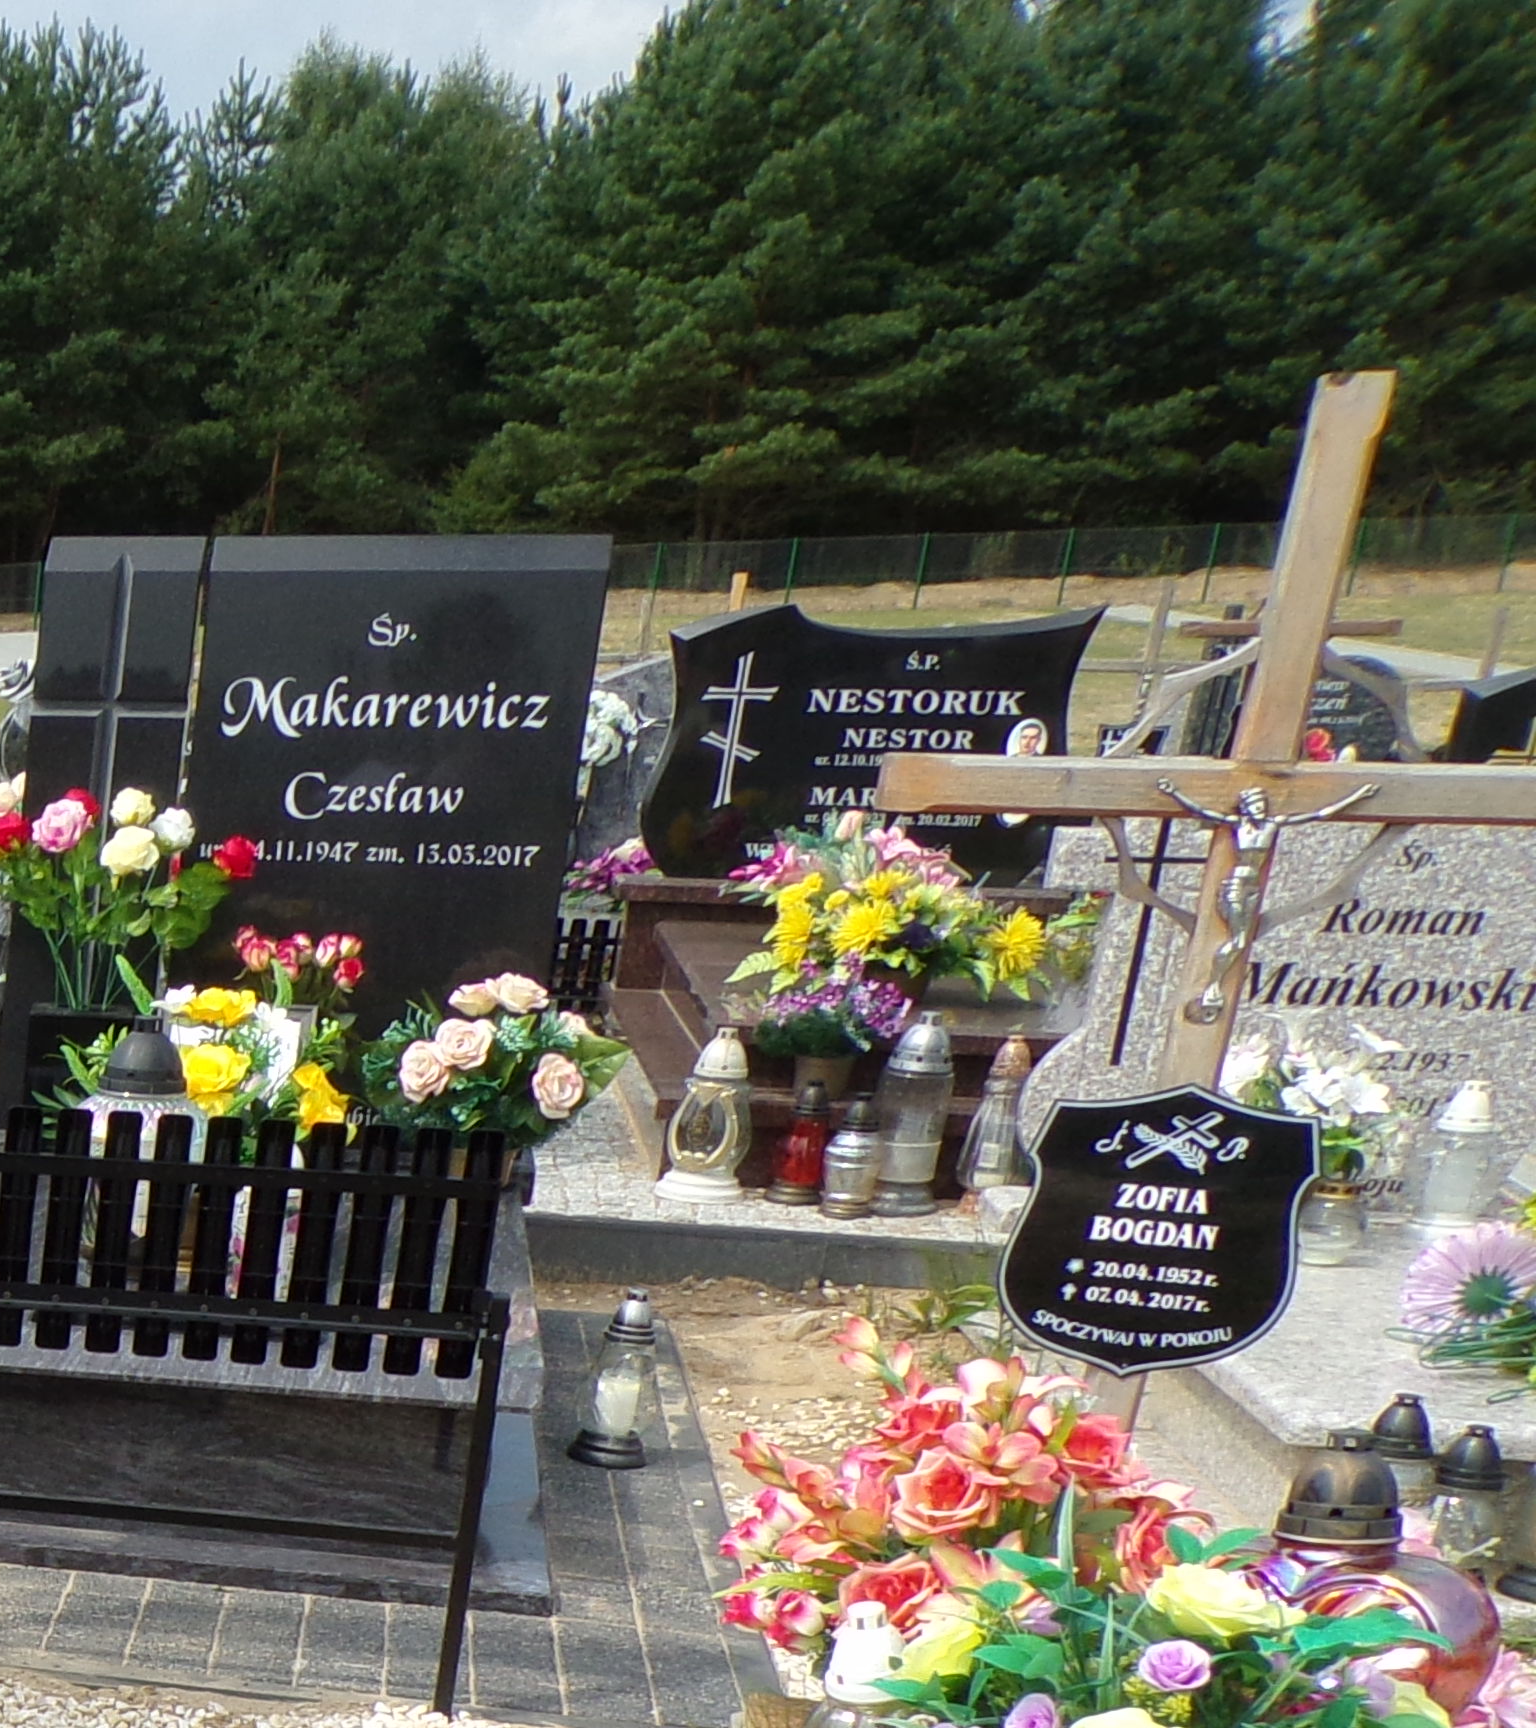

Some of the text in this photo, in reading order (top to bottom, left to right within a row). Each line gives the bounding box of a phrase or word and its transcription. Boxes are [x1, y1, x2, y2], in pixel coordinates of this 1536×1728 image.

[220, 675, 551, 738] Makarewicz
[806, 688, 1026, 716] NESTORUK
[842, 727, 975, 750] NESTOR
[834, 753, 883, 767] 12.10.19
[284, 772, 465, 821] Czesław
[809, 786, 877, 807] MAR
[253, 838, 359, 863] 4.11.1947
[366, 847, 405, 865] zm.
[416, 842, 542, 868] 13.03.2017
[1321, 898, 1487, 937] Roman
[1115, 1182, 1209, 1215] ZOFIA
[1089, 1215, 1220, 1251] BOGDAN
[1031, 1308, 1233, 1349] SPOCZYWAJ W POKOJU
